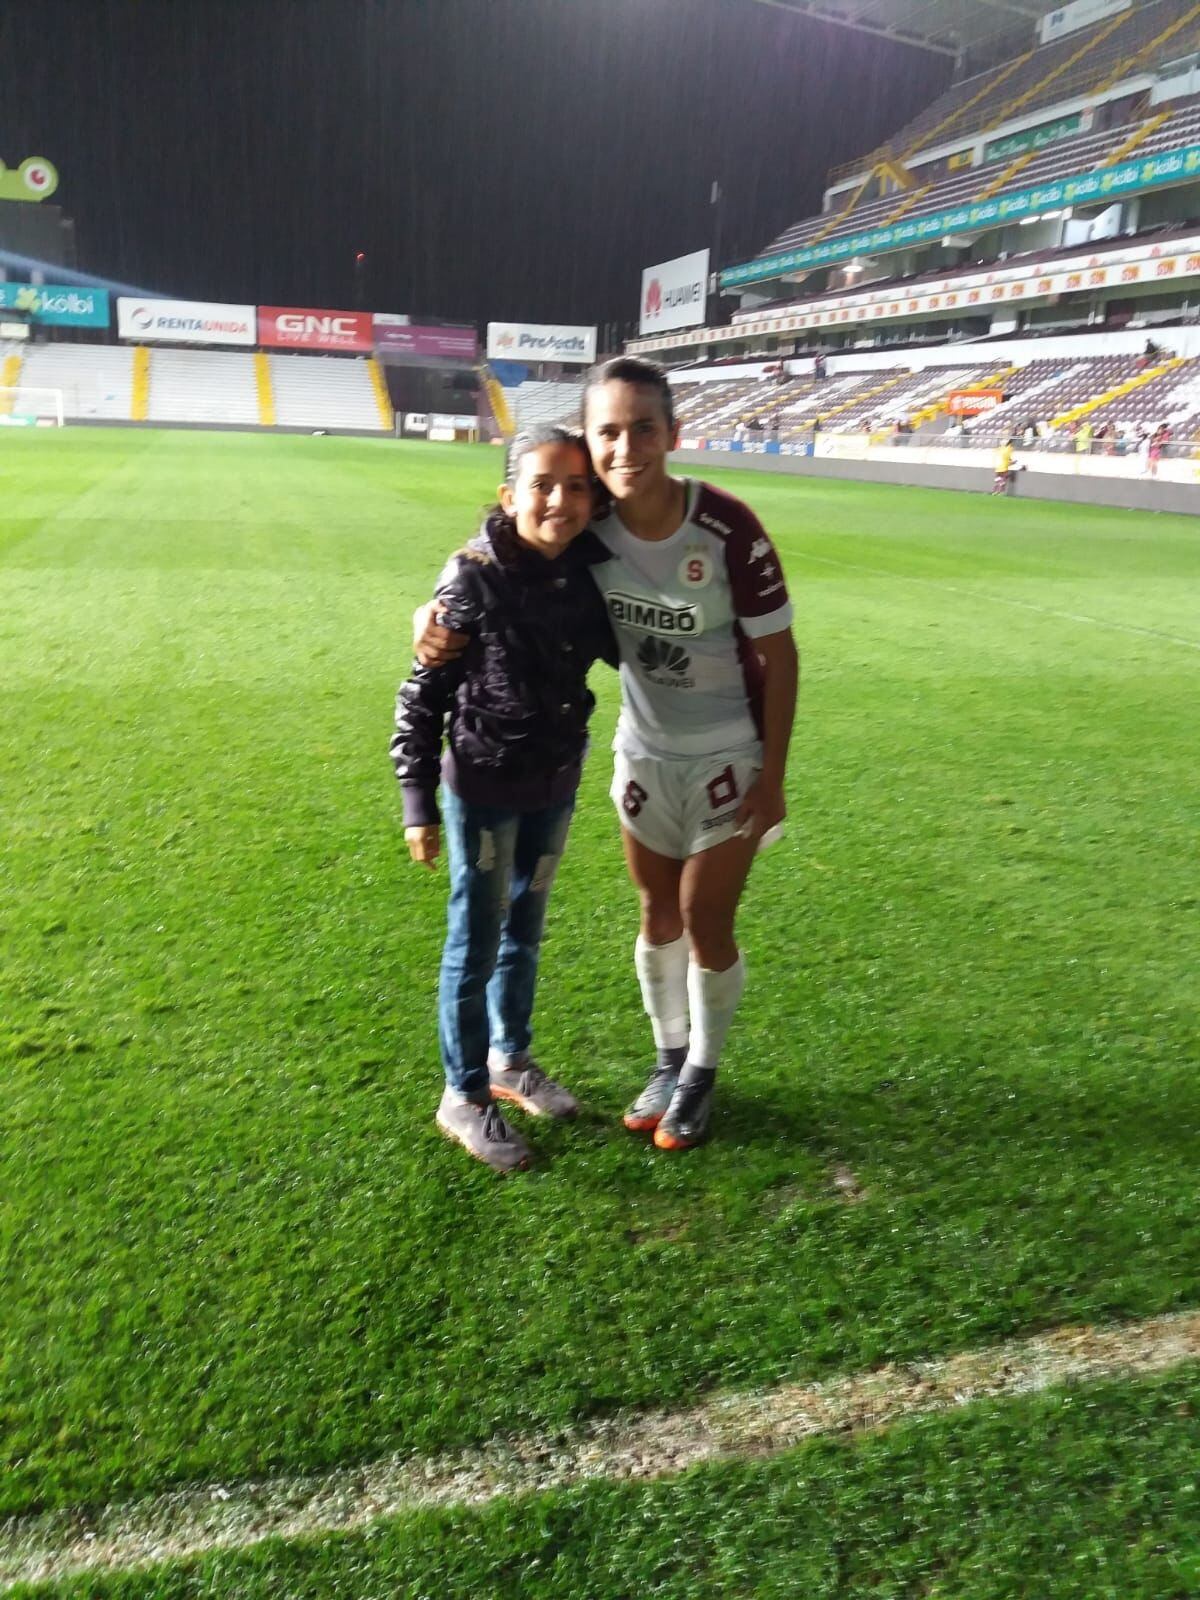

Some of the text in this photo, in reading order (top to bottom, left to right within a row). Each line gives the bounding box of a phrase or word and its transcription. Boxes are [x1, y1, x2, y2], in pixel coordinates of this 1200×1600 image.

[277, 314, 358, 335] GNC
[278, 334, 358, 345] LIVE WELL
[687, 560, 704, 581] S
[609, 599, 695, 632] BIMBO
